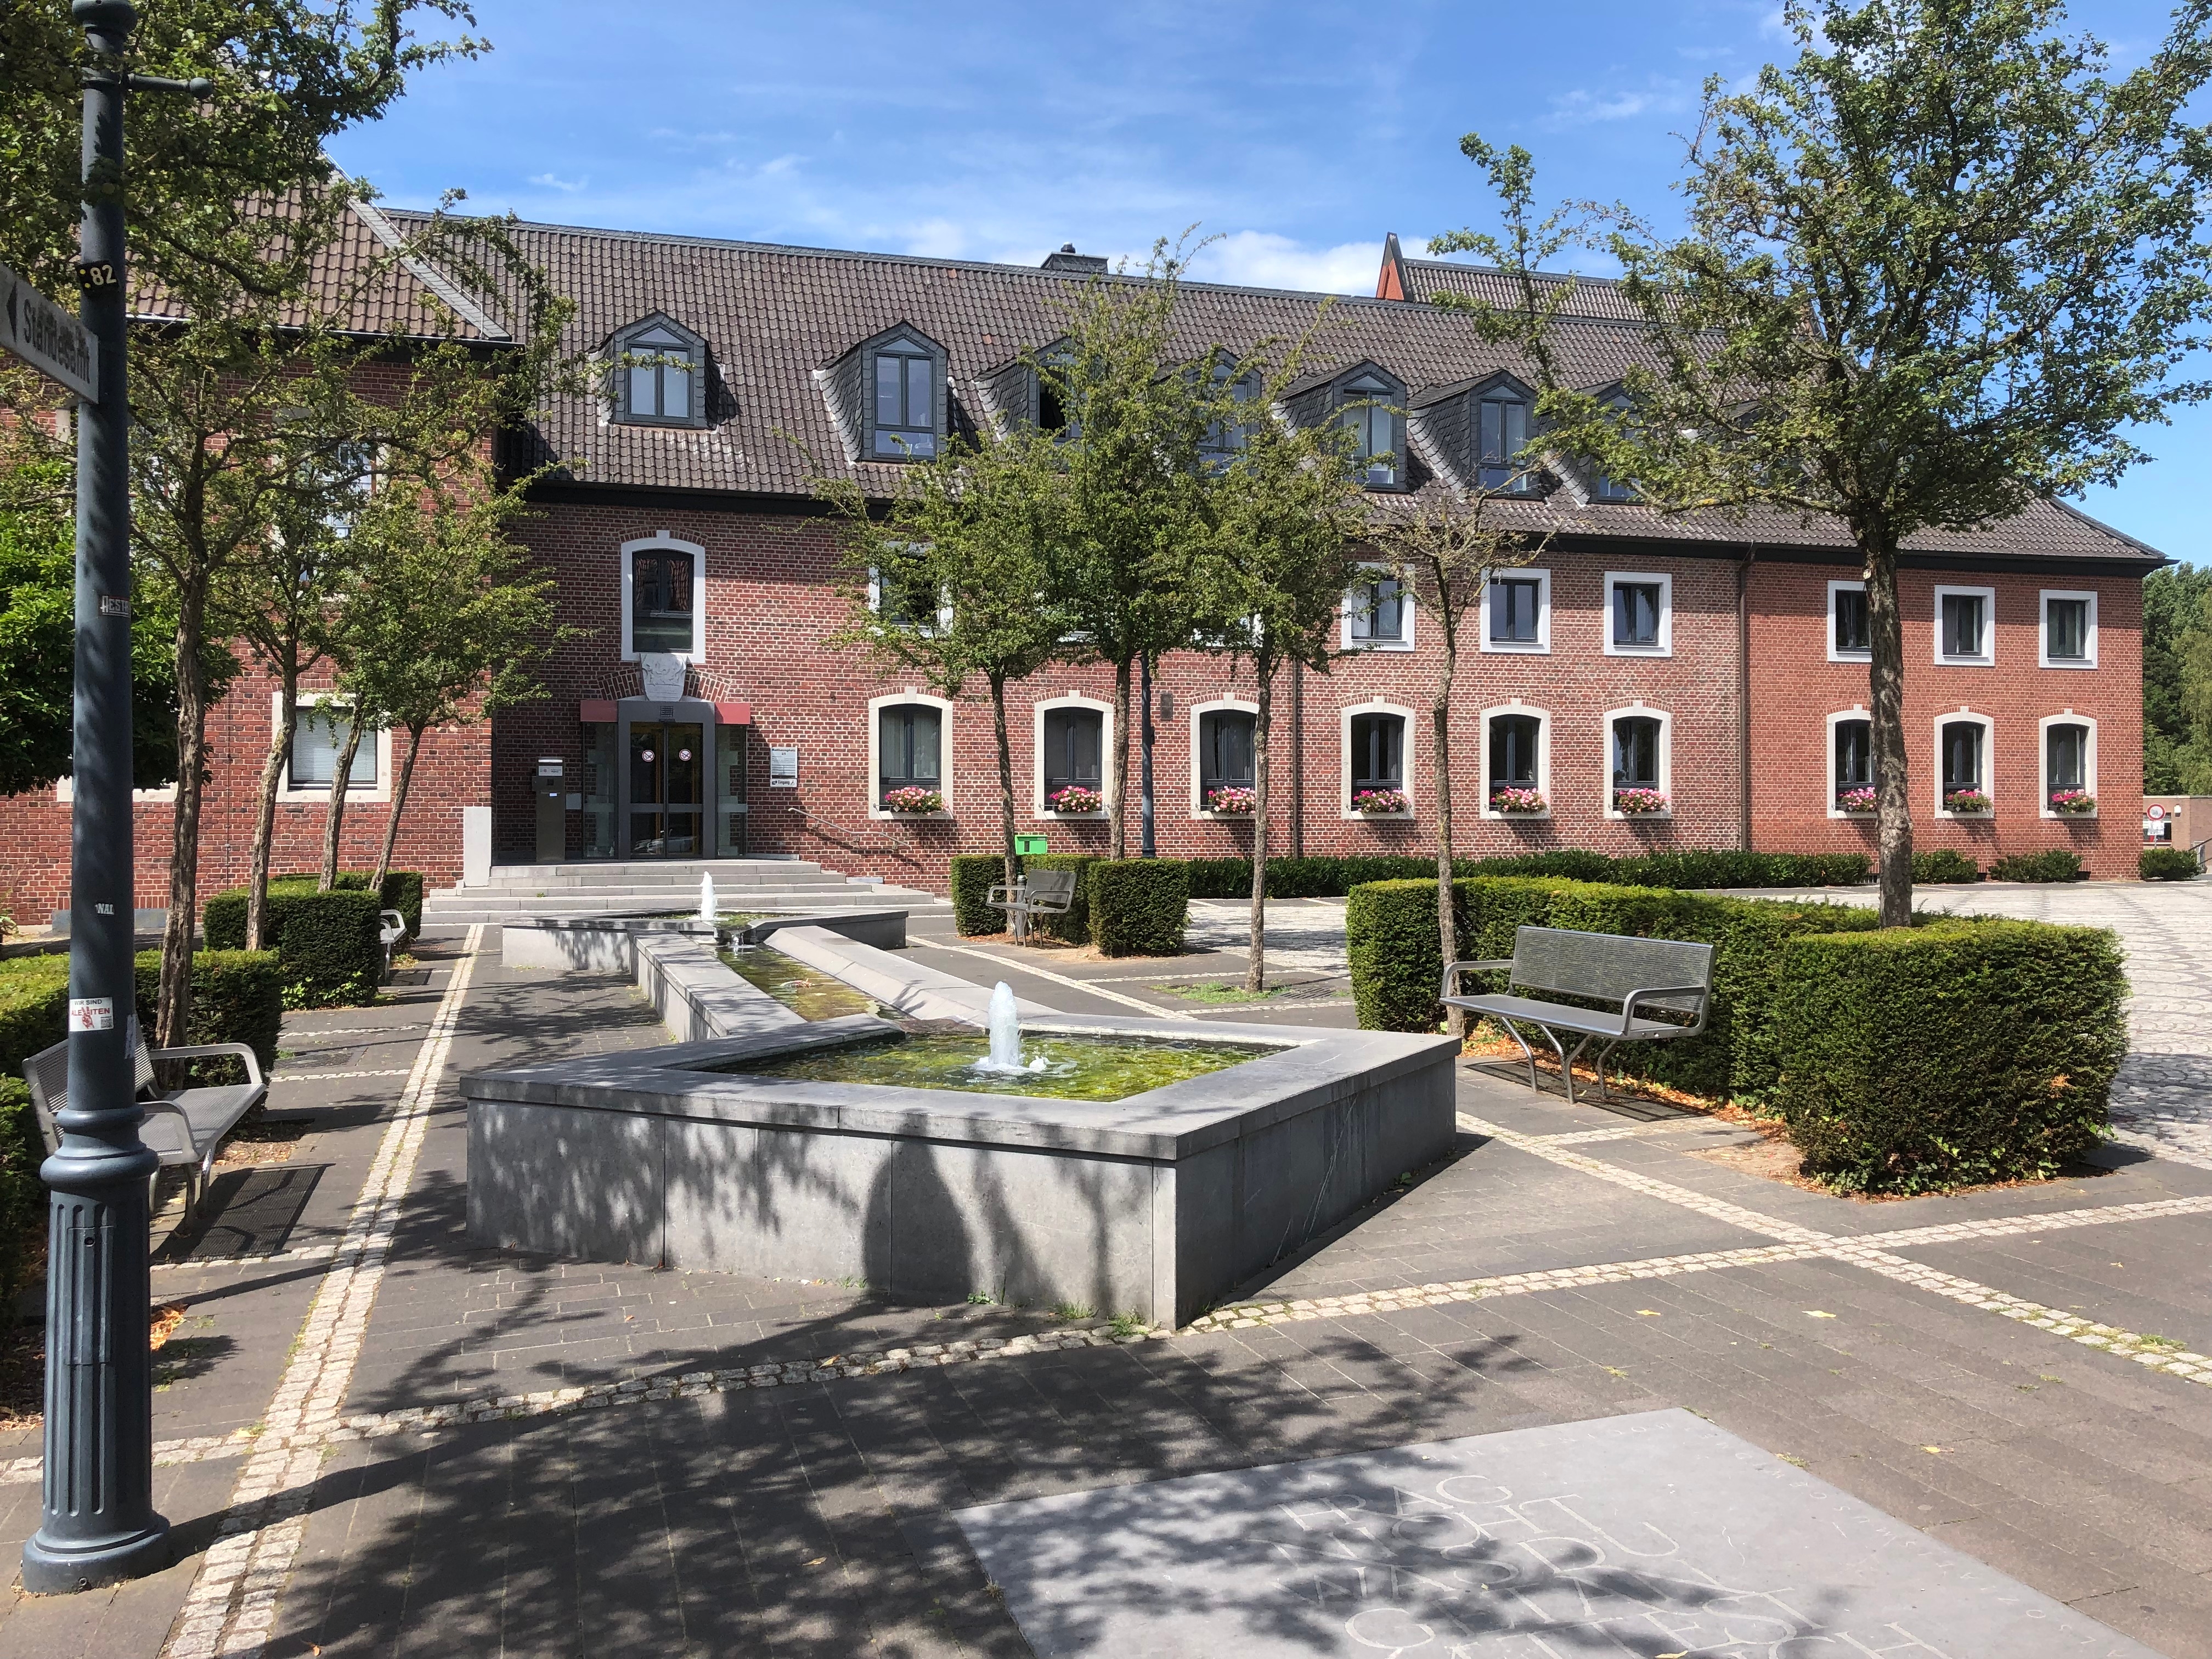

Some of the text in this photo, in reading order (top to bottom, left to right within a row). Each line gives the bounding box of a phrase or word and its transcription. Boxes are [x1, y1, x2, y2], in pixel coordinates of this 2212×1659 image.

[90, 264, 117, 286] 82
[24, 298, 91, 384] Standesamt
[95, 903, 115, 915] NAL
